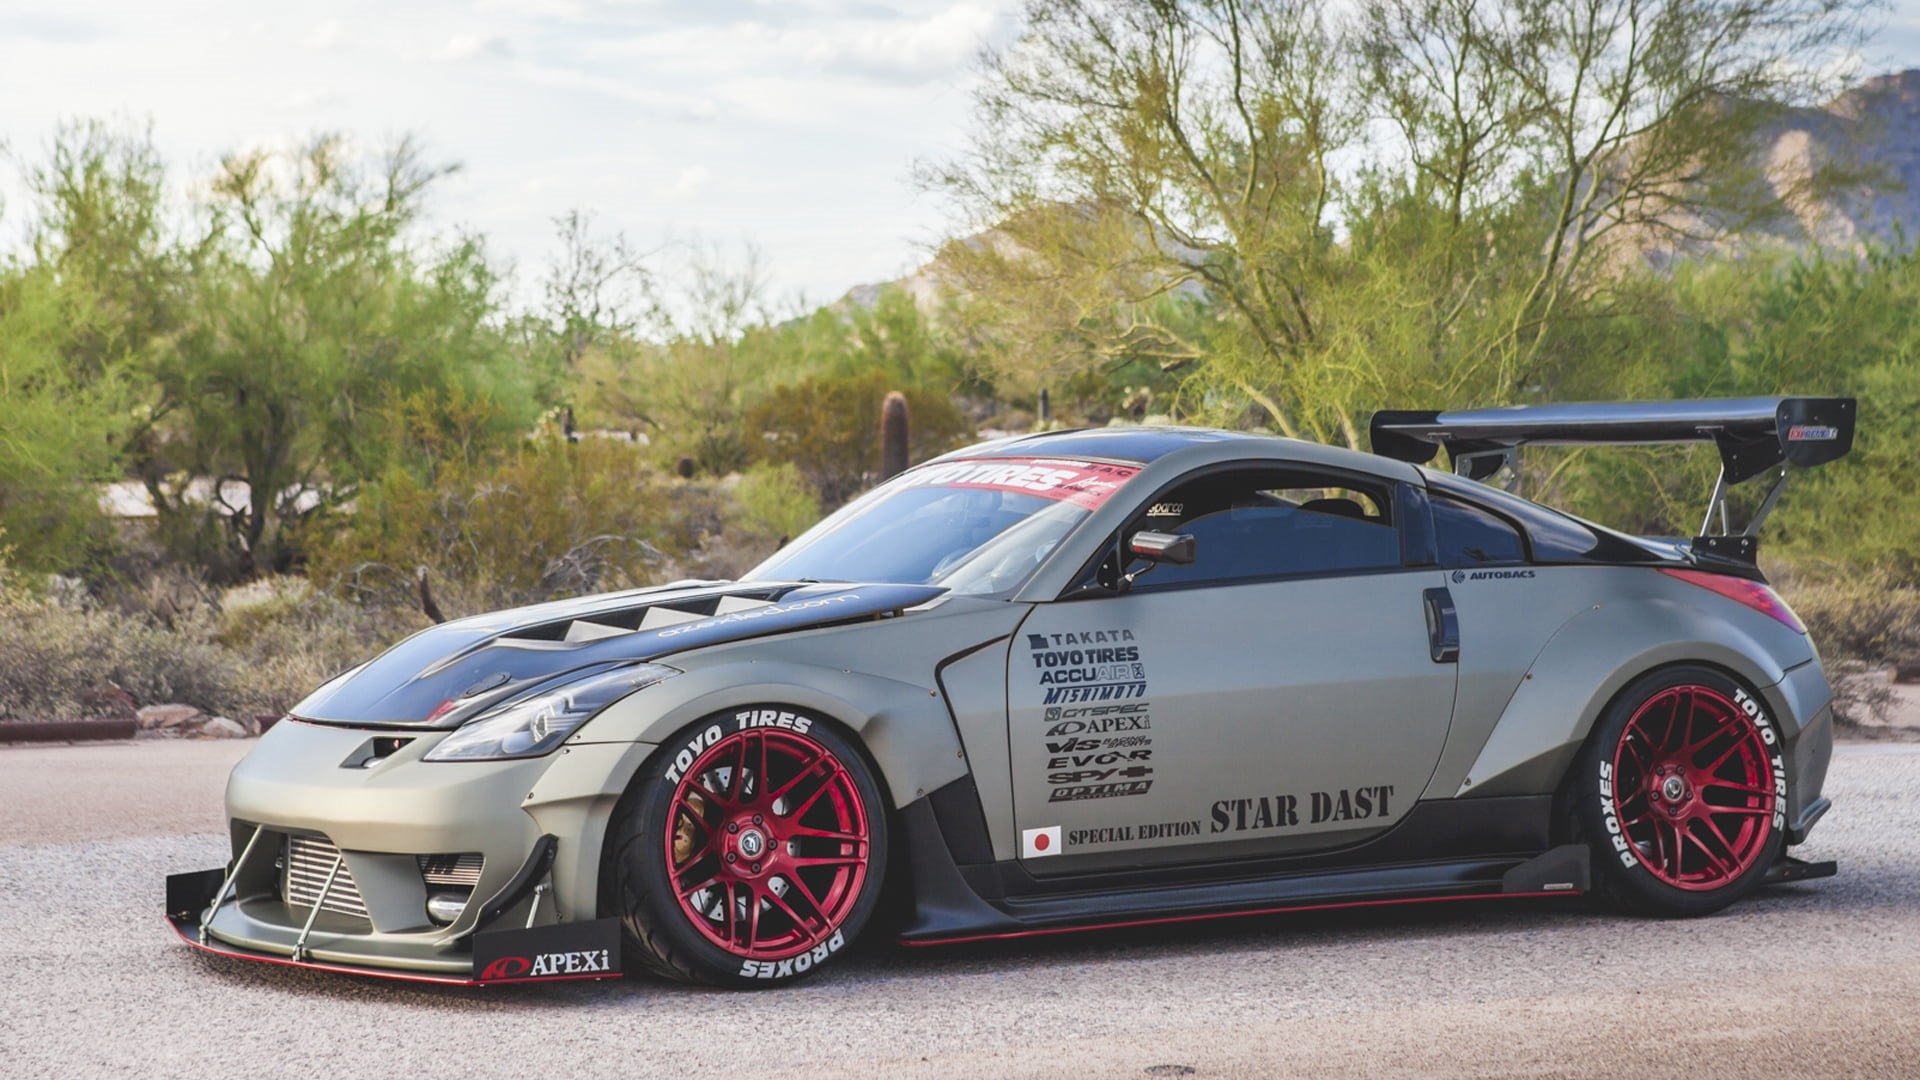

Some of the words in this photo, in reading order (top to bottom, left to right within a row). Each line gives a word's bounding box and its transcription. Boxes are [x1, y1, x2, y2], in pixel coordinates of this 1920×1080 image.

[1470, 570, 1536, 580] AUTOBACS
[1050, 629, 1135, 646] TAKATA
[1032, 650, 1084, 668] TOYO
[1084, 646, 1139, 664] TIRES
[1039, 665, 1129, 685] ACCUAIR
[1042, 681, 1147, 705] MISHIMOTO
[664, 724, 723, 785] TOYO
[736, 710, 812, 735] TIRES
[1732, 688, 1776, 746] TOYO
[1771, 754, 1787, 832] TIRES
[1055, 781, 1148, 797] OPTIMA
[1068, 825, 1135, 845] SPECIAL
[1138, 820, 1201, 839] EDITION
[1210, 795, 1299, 833] STAR
[1310, 785, 1394, 824] DAST
[1600, 760, 1638, 869] PROXES
[739, 928, 845, 979] PROXES
